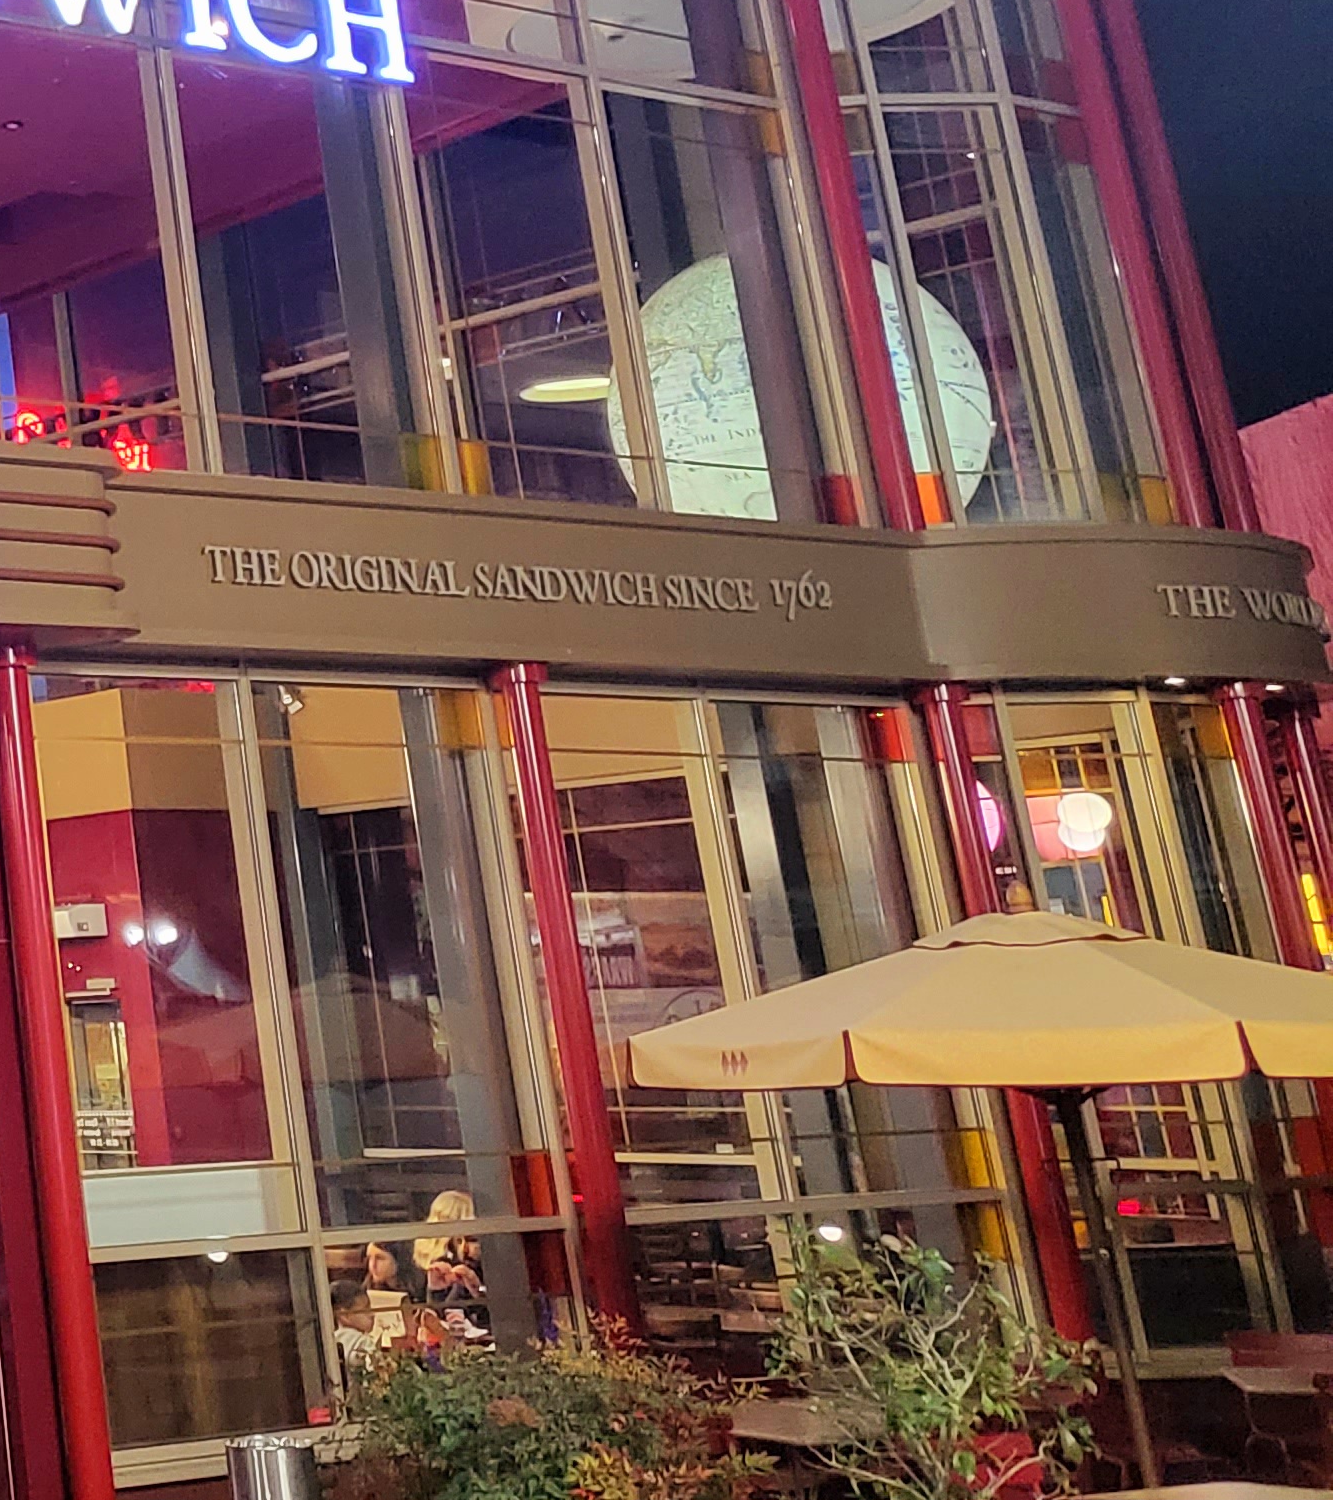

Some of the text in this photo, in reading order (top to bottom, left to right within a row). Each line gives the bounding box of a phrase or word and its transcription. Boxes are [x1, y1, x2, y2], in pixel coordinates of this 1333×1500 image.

[202, 545, 832, 622] THE ORIGINAL SANDWICH SINCE 1762
[1156, 584, 1237, 618] THE
